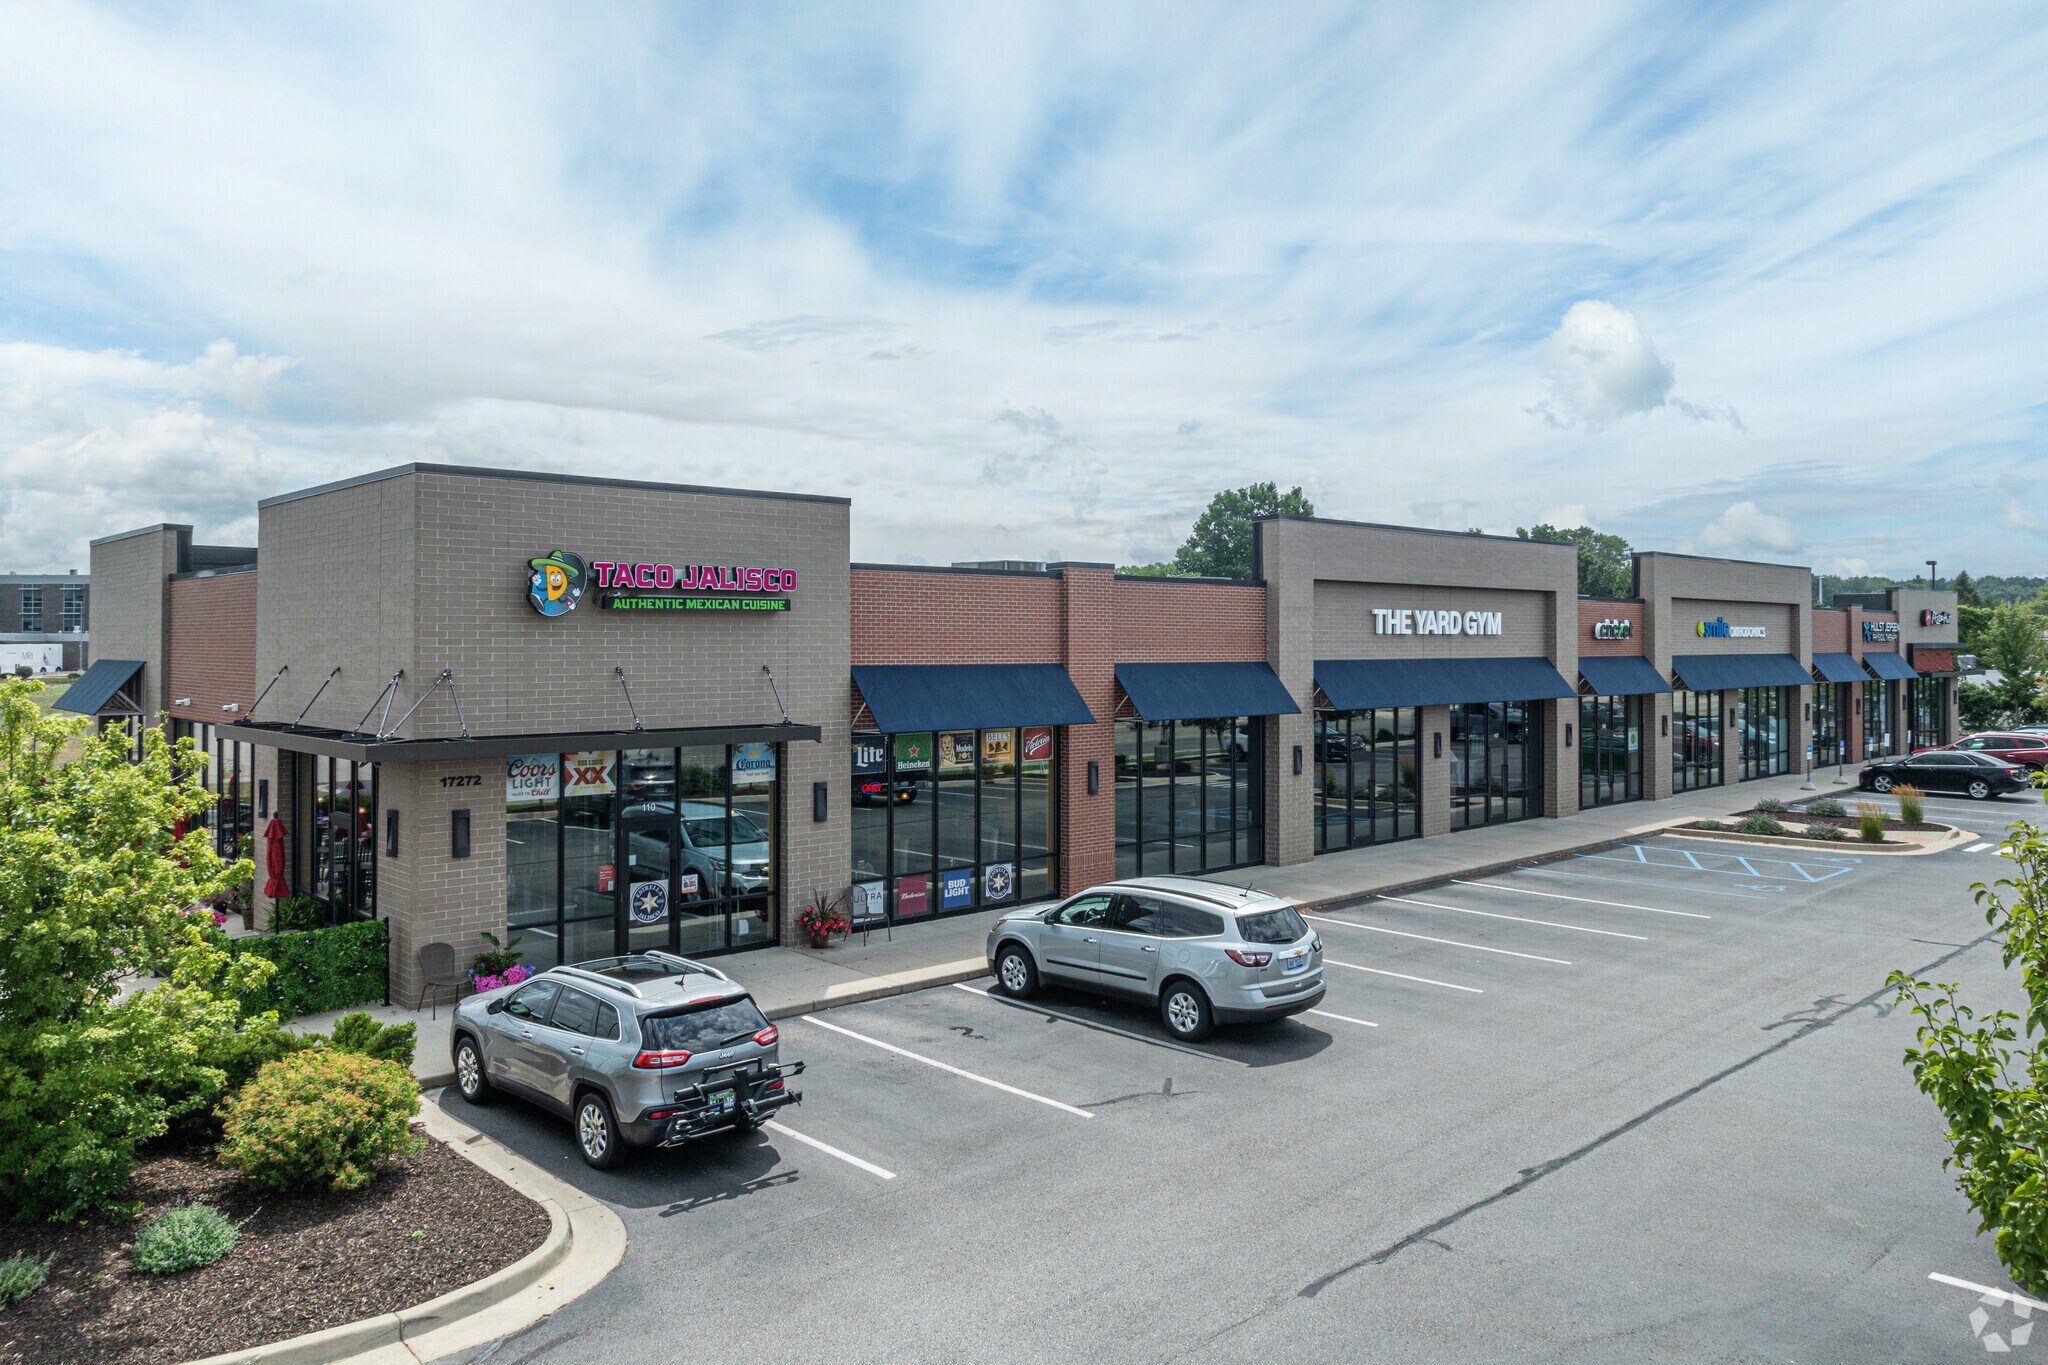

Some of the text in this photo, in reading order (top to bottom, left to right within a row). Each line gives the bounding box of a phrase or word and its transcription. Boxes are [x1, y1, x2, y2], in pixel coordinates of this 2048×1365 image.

[594, 562, 797, 592] TACO JALISCO
[613, 598, 785, 610] AUTHENTIC MEXICAN CUISINE
[1372, 608, 1502, 636] THE YARD GYM
[1705, 617, 1729, 638] smile
[955, 743, 974, 753] Modelo
[856, 746, 884, 768] Lite
[507, 759, 556, 778] Coors
[736, 759, 773, 772] Corona
[897, 760, 931, 770] Heineken
[440, 775, 482, 787] 17272
[573, 766, 608, 785] XX
[512, 777, 551, 789] LIGHT
[861, 783, 882, 793] OPEN
[642, 803, 656, 811] 110
[948, 879, 966, 889] BUD
[635, 883, 663, 898] ESTRELLA
[901, 892, 926, 900] Budweiser
[944, 886, 969, 898] LIGHT
[638, 910, 660, 920] JALISCO
